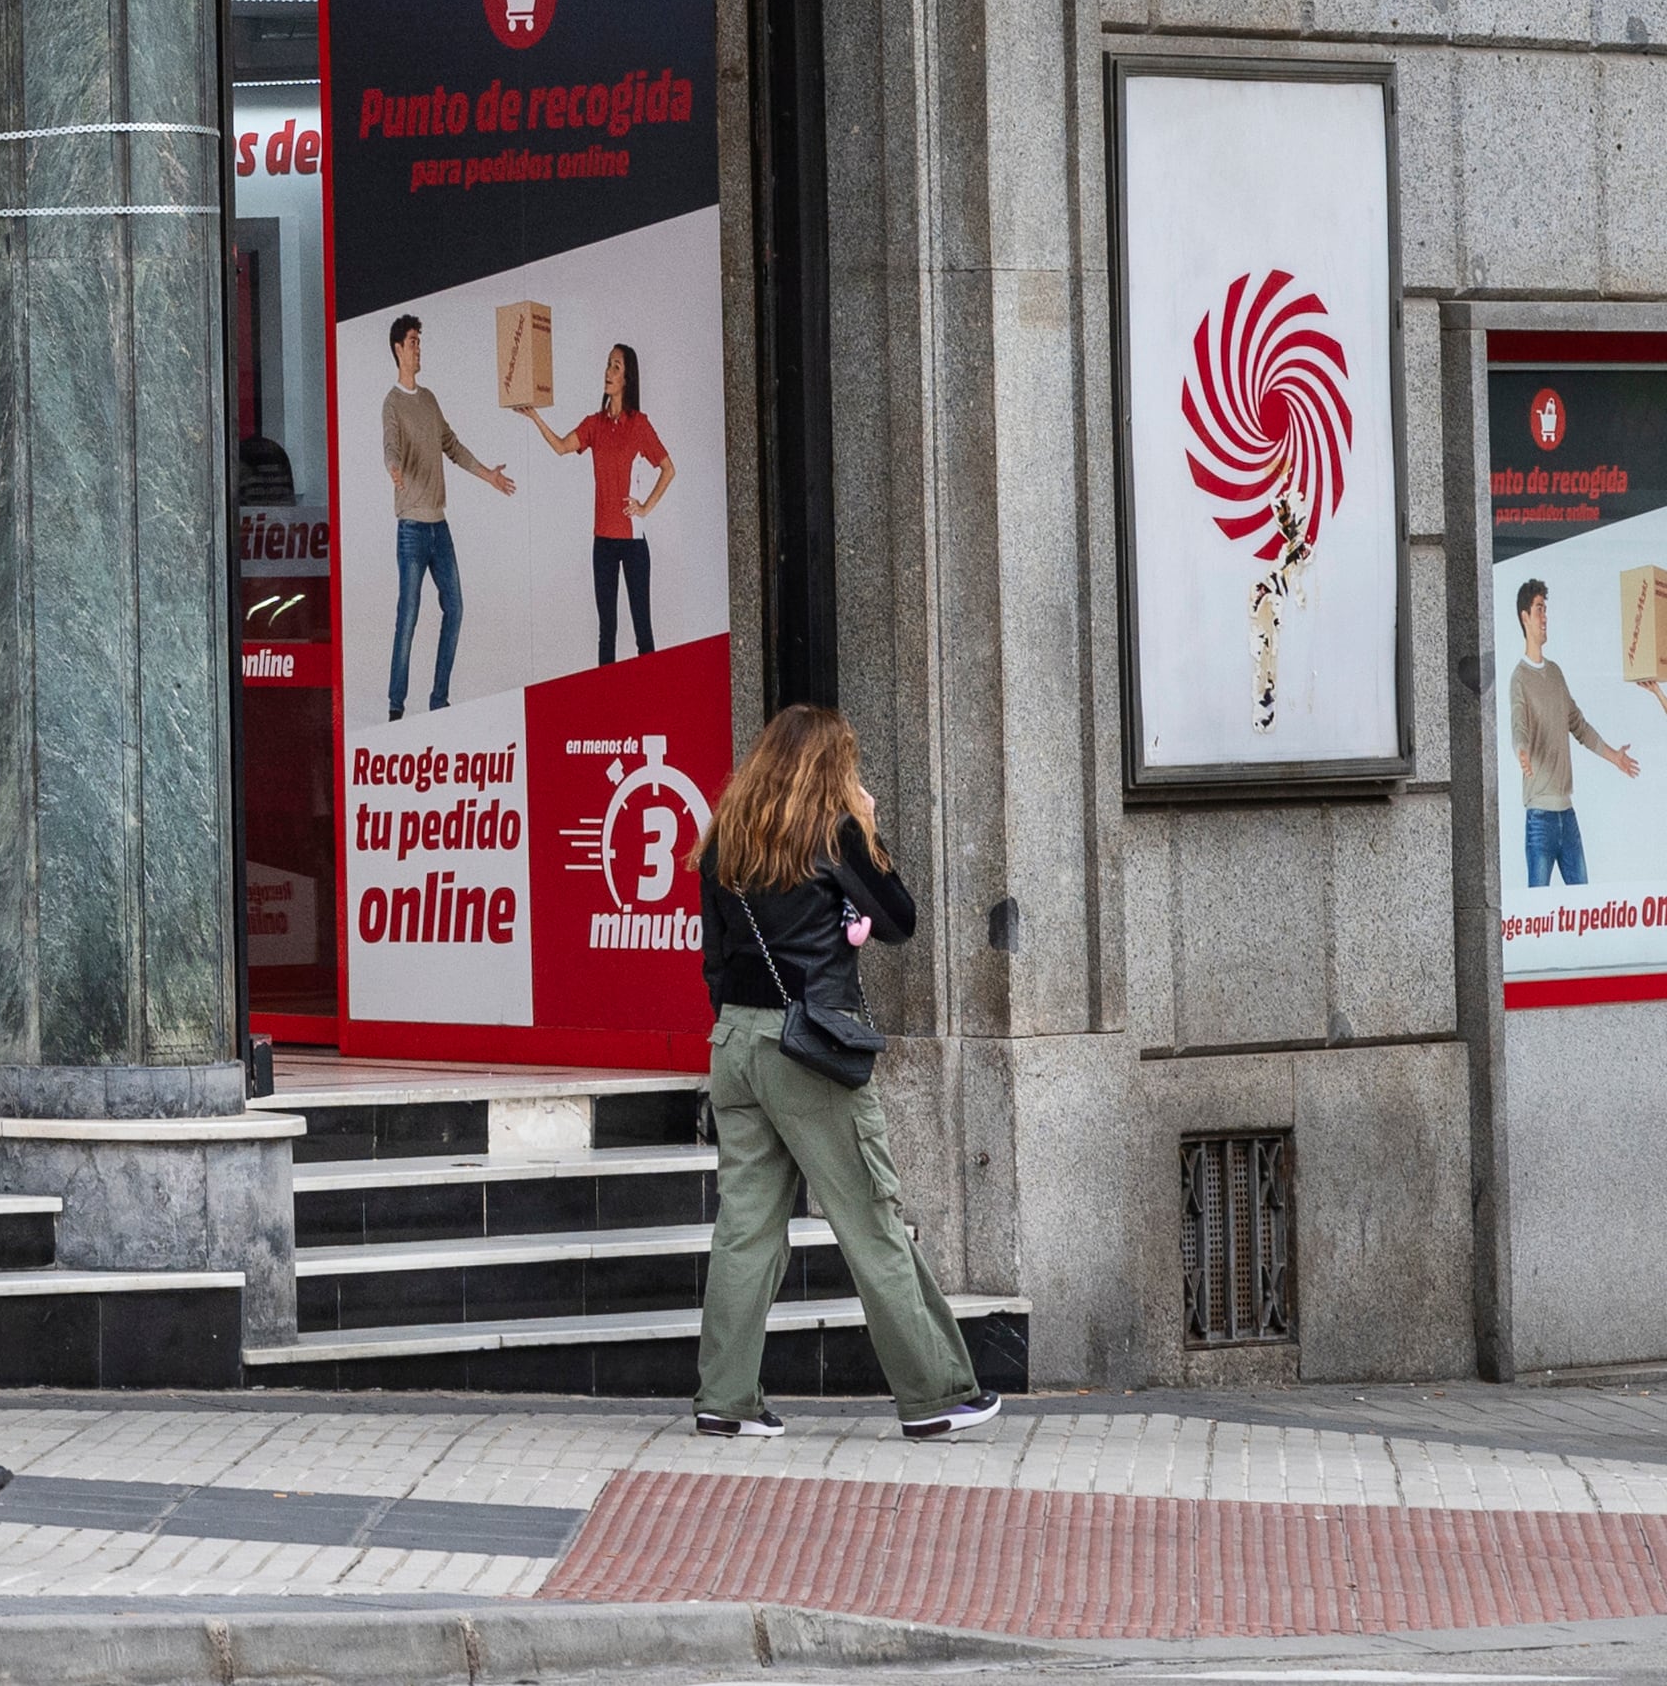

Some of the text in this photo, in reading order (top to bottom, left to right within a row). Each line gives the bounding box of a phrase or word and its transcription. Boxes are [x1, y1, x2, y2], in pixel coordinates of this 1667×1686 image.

[359, 68, 694, 140] Punto de recogida
[410, 147, 630, 193] para pedidos online
[1527, 464, 1628, 500] de recogida
[353, 742, 517, 794] Recoge aquí
[566, 735, 639, 754] en menos de
[355, 800, 522, 861] tu pedido
[636, 805, 679, 902] 3
[358, 871, 517, 945] online
[1524, 899, 1638, 938] aquí tu pedido
